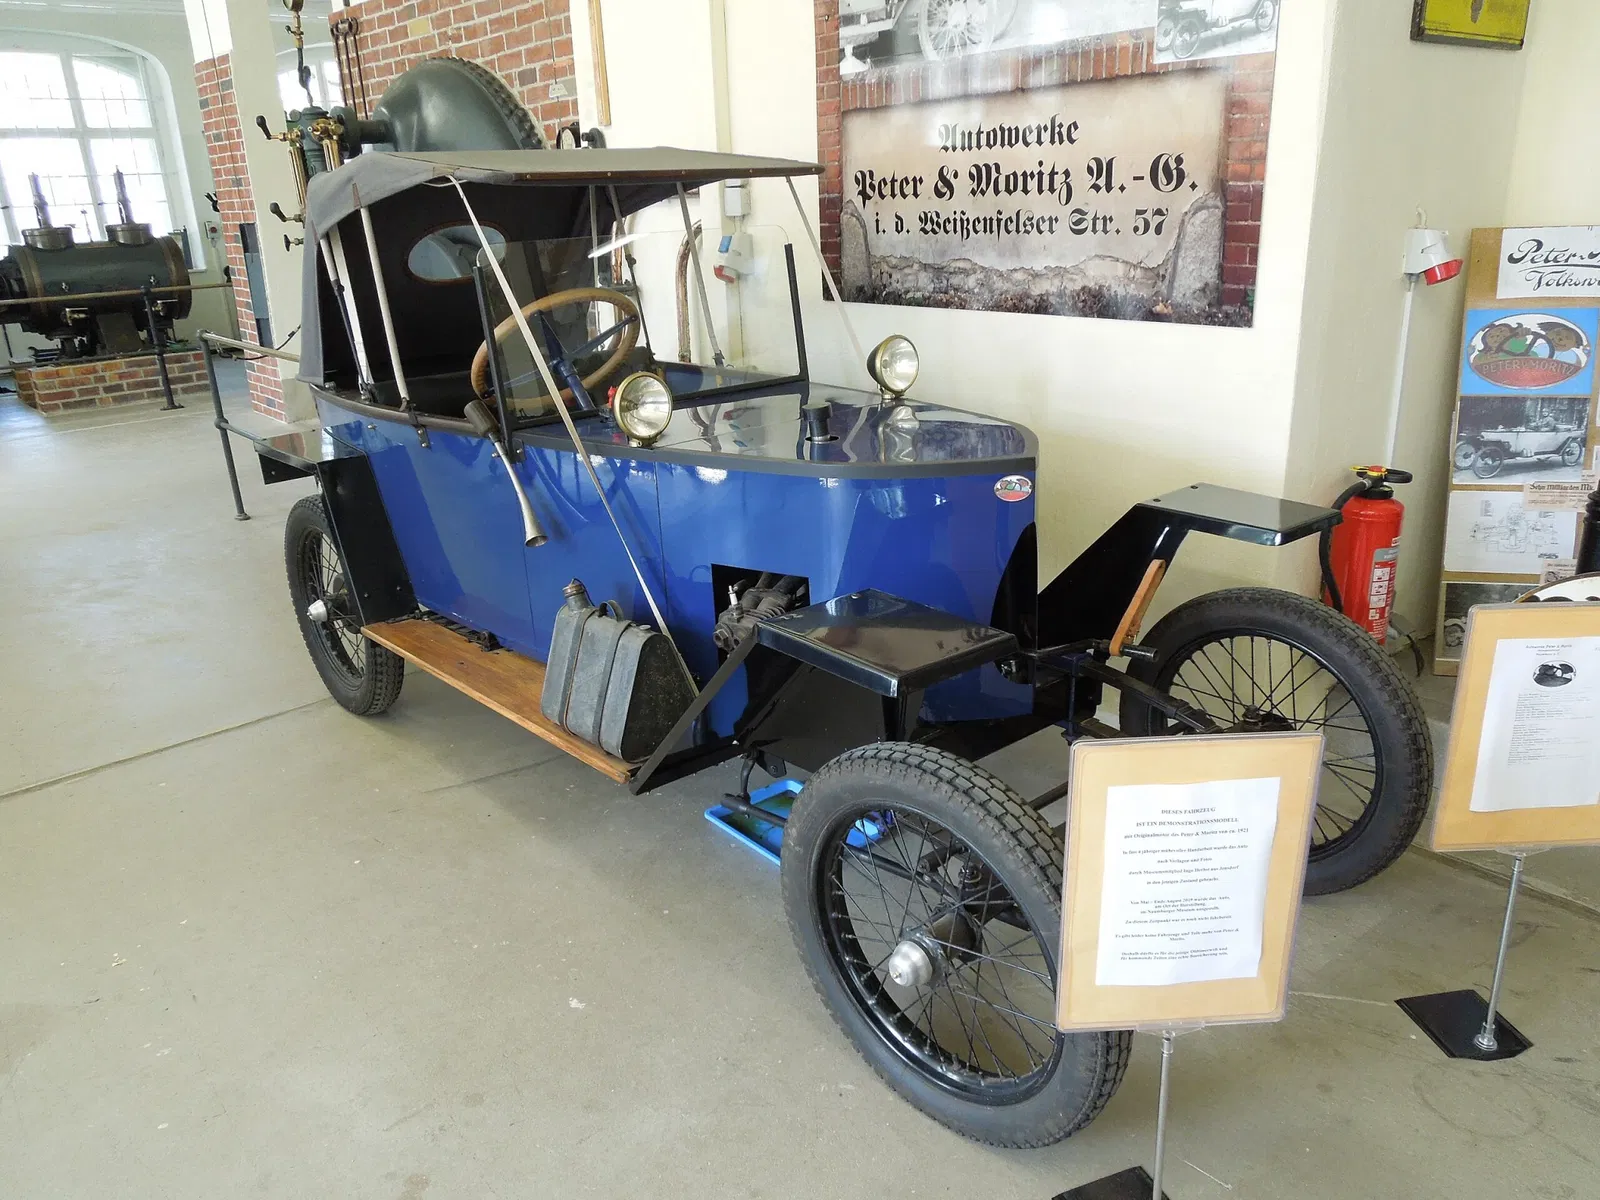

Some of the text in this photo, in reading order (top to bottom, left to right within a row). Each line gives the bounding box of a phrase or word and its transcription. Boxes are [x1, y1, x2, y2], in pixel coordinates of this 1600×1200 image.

[939, 114, 1080, 152] Autowerke
[854, 169, 924, 208] Peter
[934, 165, 958, 200] &
[968, 160, 1073, 206] Moritz
[875, 208, 1169, 241] i. d. Weißenfelser Str. 57
[1508, 238, 1577, 264] Peter
[1482, 360, 1520, 374] PETER
[1530, 360, 1576, 375] MORITZ
